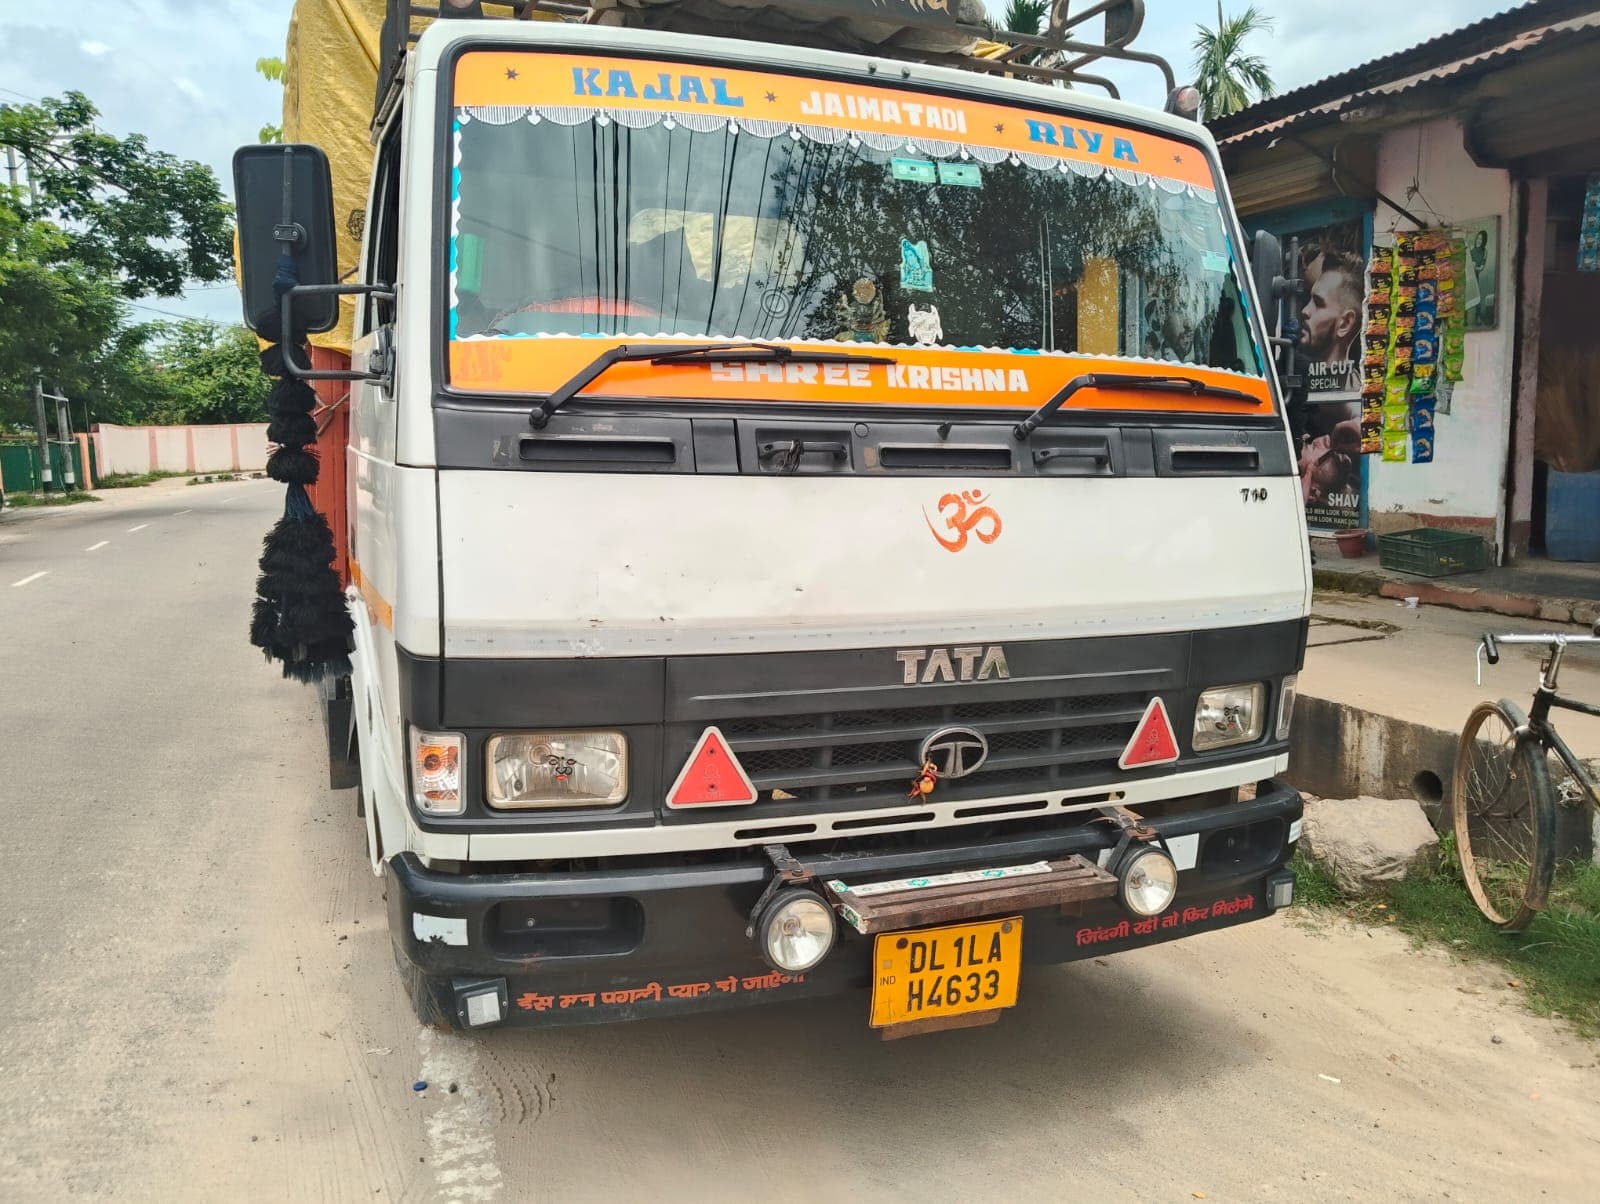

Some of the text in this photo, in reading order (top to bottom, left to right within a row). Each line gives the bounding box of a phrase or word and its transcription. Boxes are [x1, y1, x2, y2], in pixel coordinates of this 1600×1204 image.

[572, 67, 744, 107] KAJAL
[800, 91, 967, 134] JAIMATADI
[1024, 119, 1139, 164] RIYA
[711, 361, 1029, 392] SHREE KRISHNA
[1308, 360, 1355, 376] AIR CUT
[1310, 377, 1341, 390] SPECIAL
[897, 646, 1010, 684] TATA
[880, 976, 896, 986] IND
[907, 969, 1000, 1012] H4633
